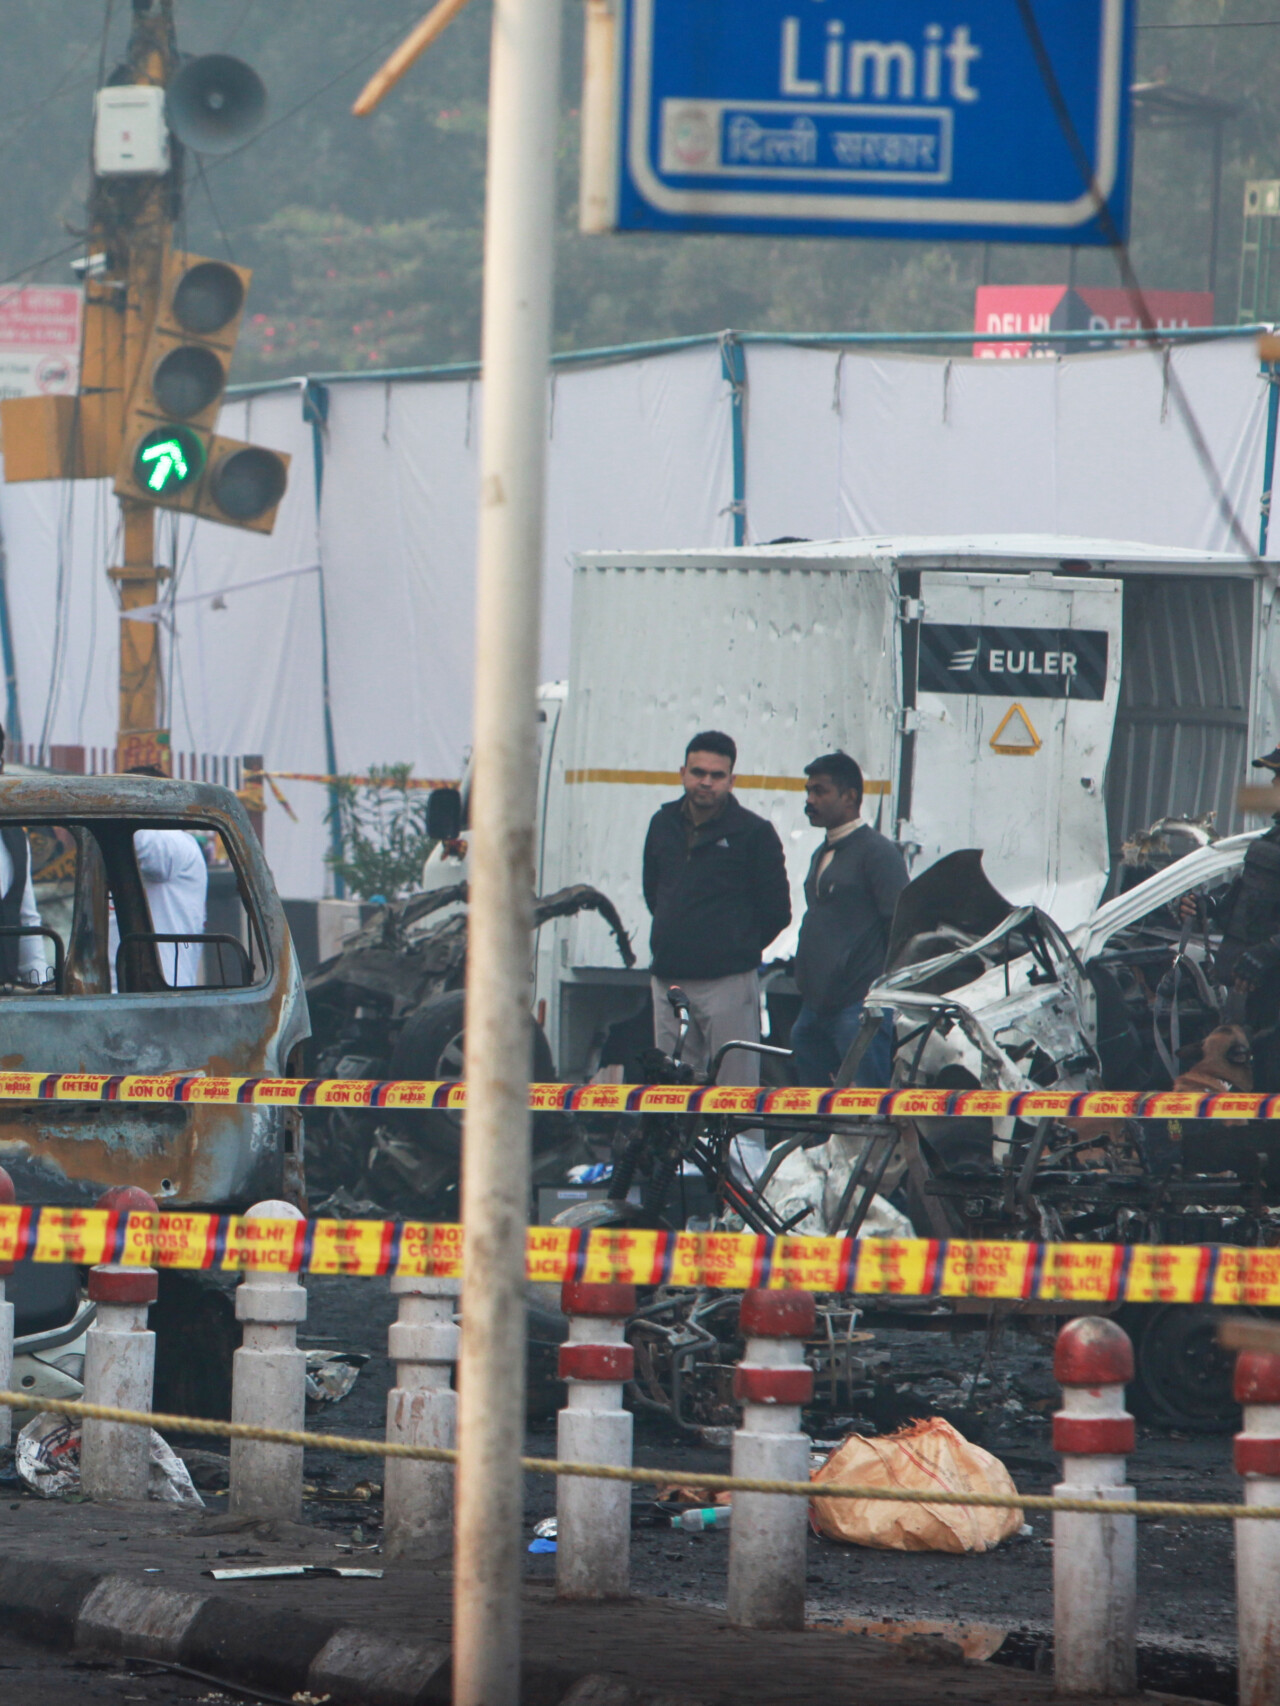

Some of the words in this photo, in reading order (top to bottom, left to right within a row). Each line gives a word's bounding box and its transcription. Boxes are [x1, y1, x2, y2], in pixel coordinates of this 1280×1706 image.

[781, 16, 980, 102] Limit
[728, 115, 817, 165] दिल्ली
[831, 132, 938, 167] सरकार
[988, 649, 1078, 676] EULER
[128, 1086, 154, 1097] NOT
[157, 1087, 174, 1098] DO
[325, 1091, 350, 1102] NOT
[354, 1092, 370, 1102] DO
[129, 1215, 154, 1231] DO
[157, 1216, 195, 1232] NOT
[132, 1232, 190, 1249] CROSS
[234, 1224, 286, 1241] DELHI
[404, 1226, 429, 1241] DO
[530, 1235, 559, 1251] LHI
[677, 1236, 700, 1251] DO
[706, 1238, 741, 1254] NOT
[140, 1249, 180, 1265] LINE
[227, 1247, 291, 1265] POLICE
[408, 1244, 464, 1261] CROSS
[782, 1245, 832, 1261] DELHI
[949, 1244, 972, 1259] DO
[978, 1245, 1012, 1260] NOT
[1220, 1253, 1245, 1267] DO
[416, 1261, 456, 1276] LINE
[526, 1258, 565, 1275] LICE
[681, 1253, 736, 1269] CROSS
[952, 1260, 1008, 1277] CROSS
[1054, 1253, 1103, 1269] DELHI
[688, 1271, 727, 1286] LINE
[774, 1267, 836, 1284] POLICE
[1224, 1270, 1280, 1286] CROSS
[960, 1279, 999, 1294] LINE
[1045, 1275, 1106, 1293] POLICE
[1231, 1287, 1269, 1302] LINE
